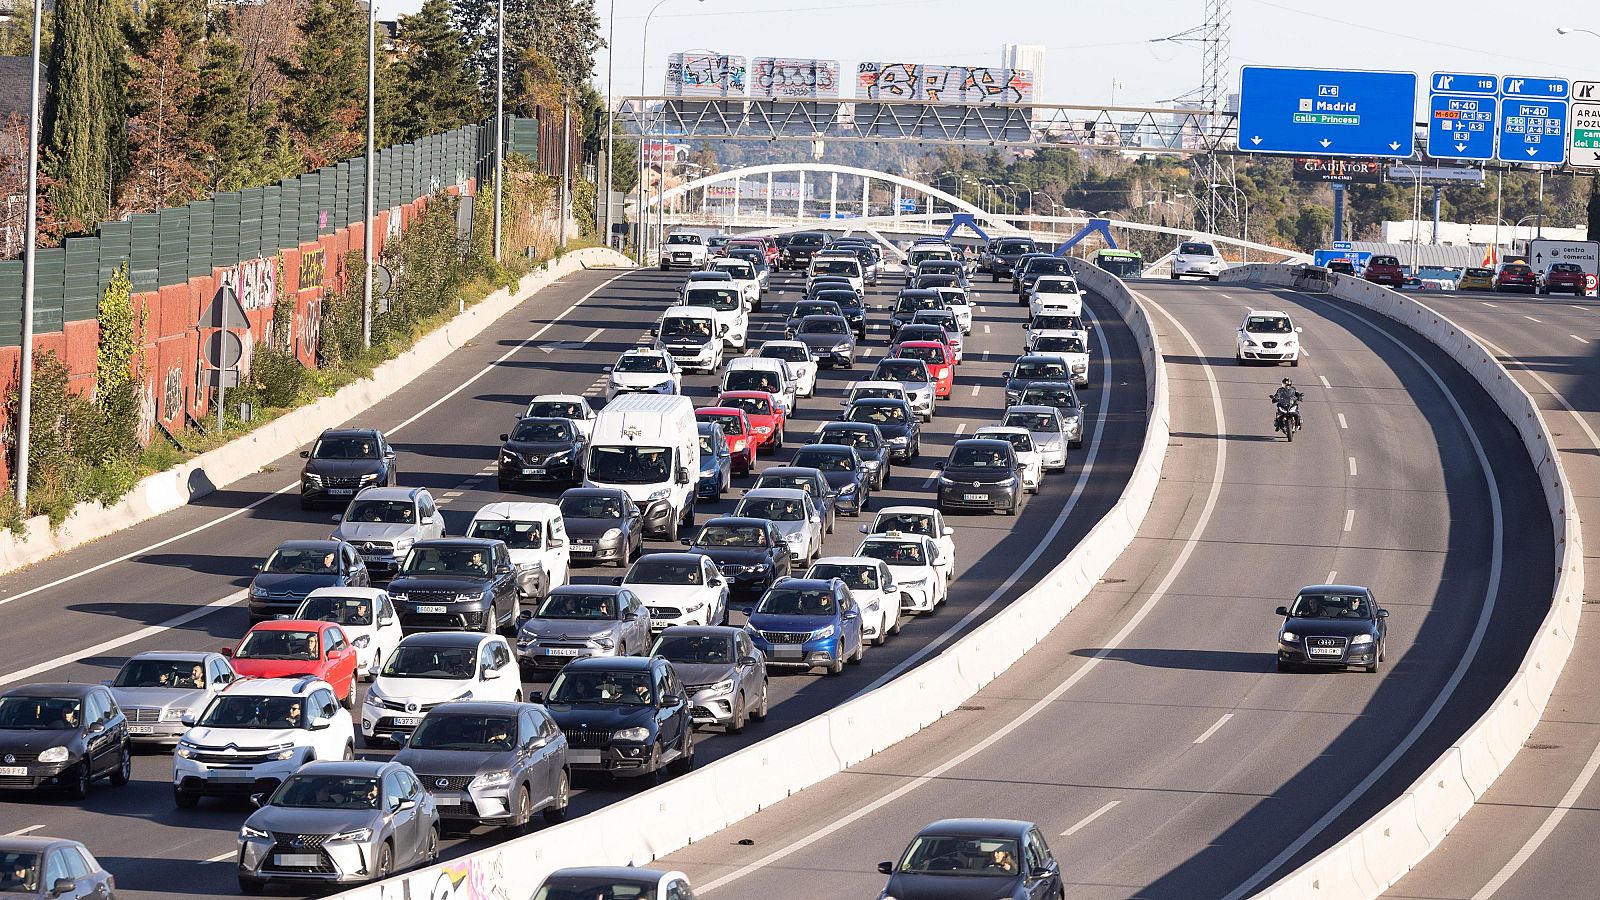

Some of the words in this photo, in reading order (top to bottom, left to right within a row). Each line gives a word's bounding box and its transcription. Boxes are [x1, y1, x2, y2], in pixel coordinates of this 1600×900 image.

[1478, 80, 1493, 89] 11B
[1548, 84, 1563, 93] 11B
[1320, 87, 1337, 95] A-6
[1316, 101, 1356, 112] Madrid
[1451, 101, 1476, 110] M-40
[1521, 107, 1547, 116] M-40
[1295, 114, 1317, 122] calle
[1321, 115, 1358, 124] Princesa
[1304, 162, 1369, 173] GLADIATOR
[12, 767, 26, 775] FYZ
